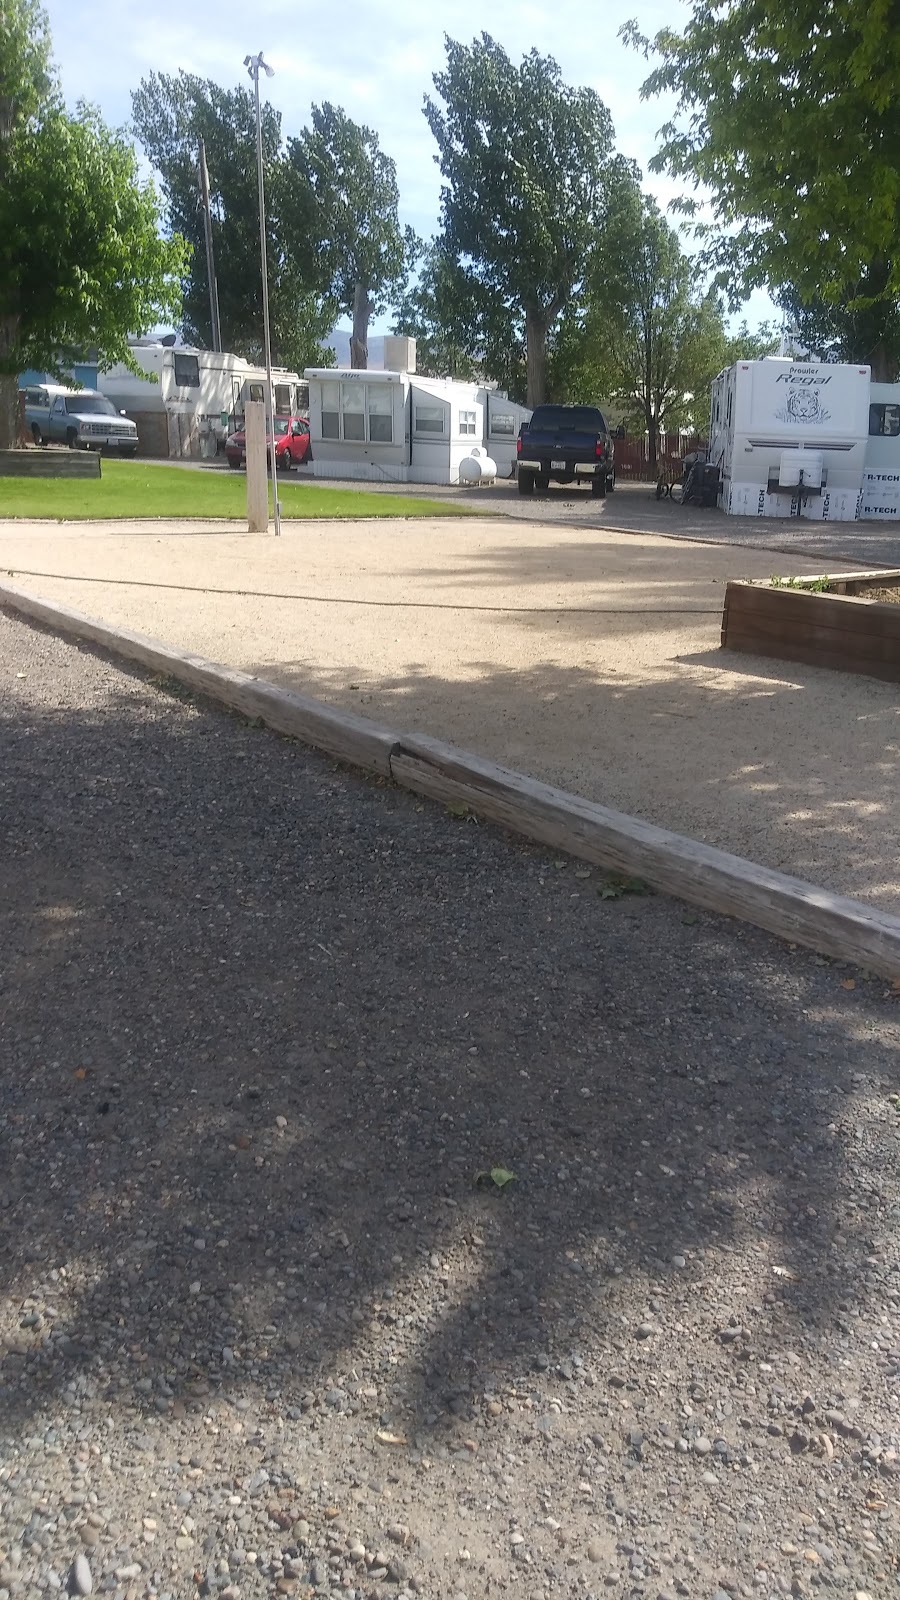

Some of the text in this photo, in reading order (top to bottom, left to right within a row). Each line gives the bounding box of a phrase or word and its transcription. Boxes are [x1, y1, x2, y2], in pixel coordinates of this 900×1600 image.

[776, 374, 832, 385] Regal
[867, 473, 900, 482] R-TECH
[864, 506, 897, 514] R-TECH
